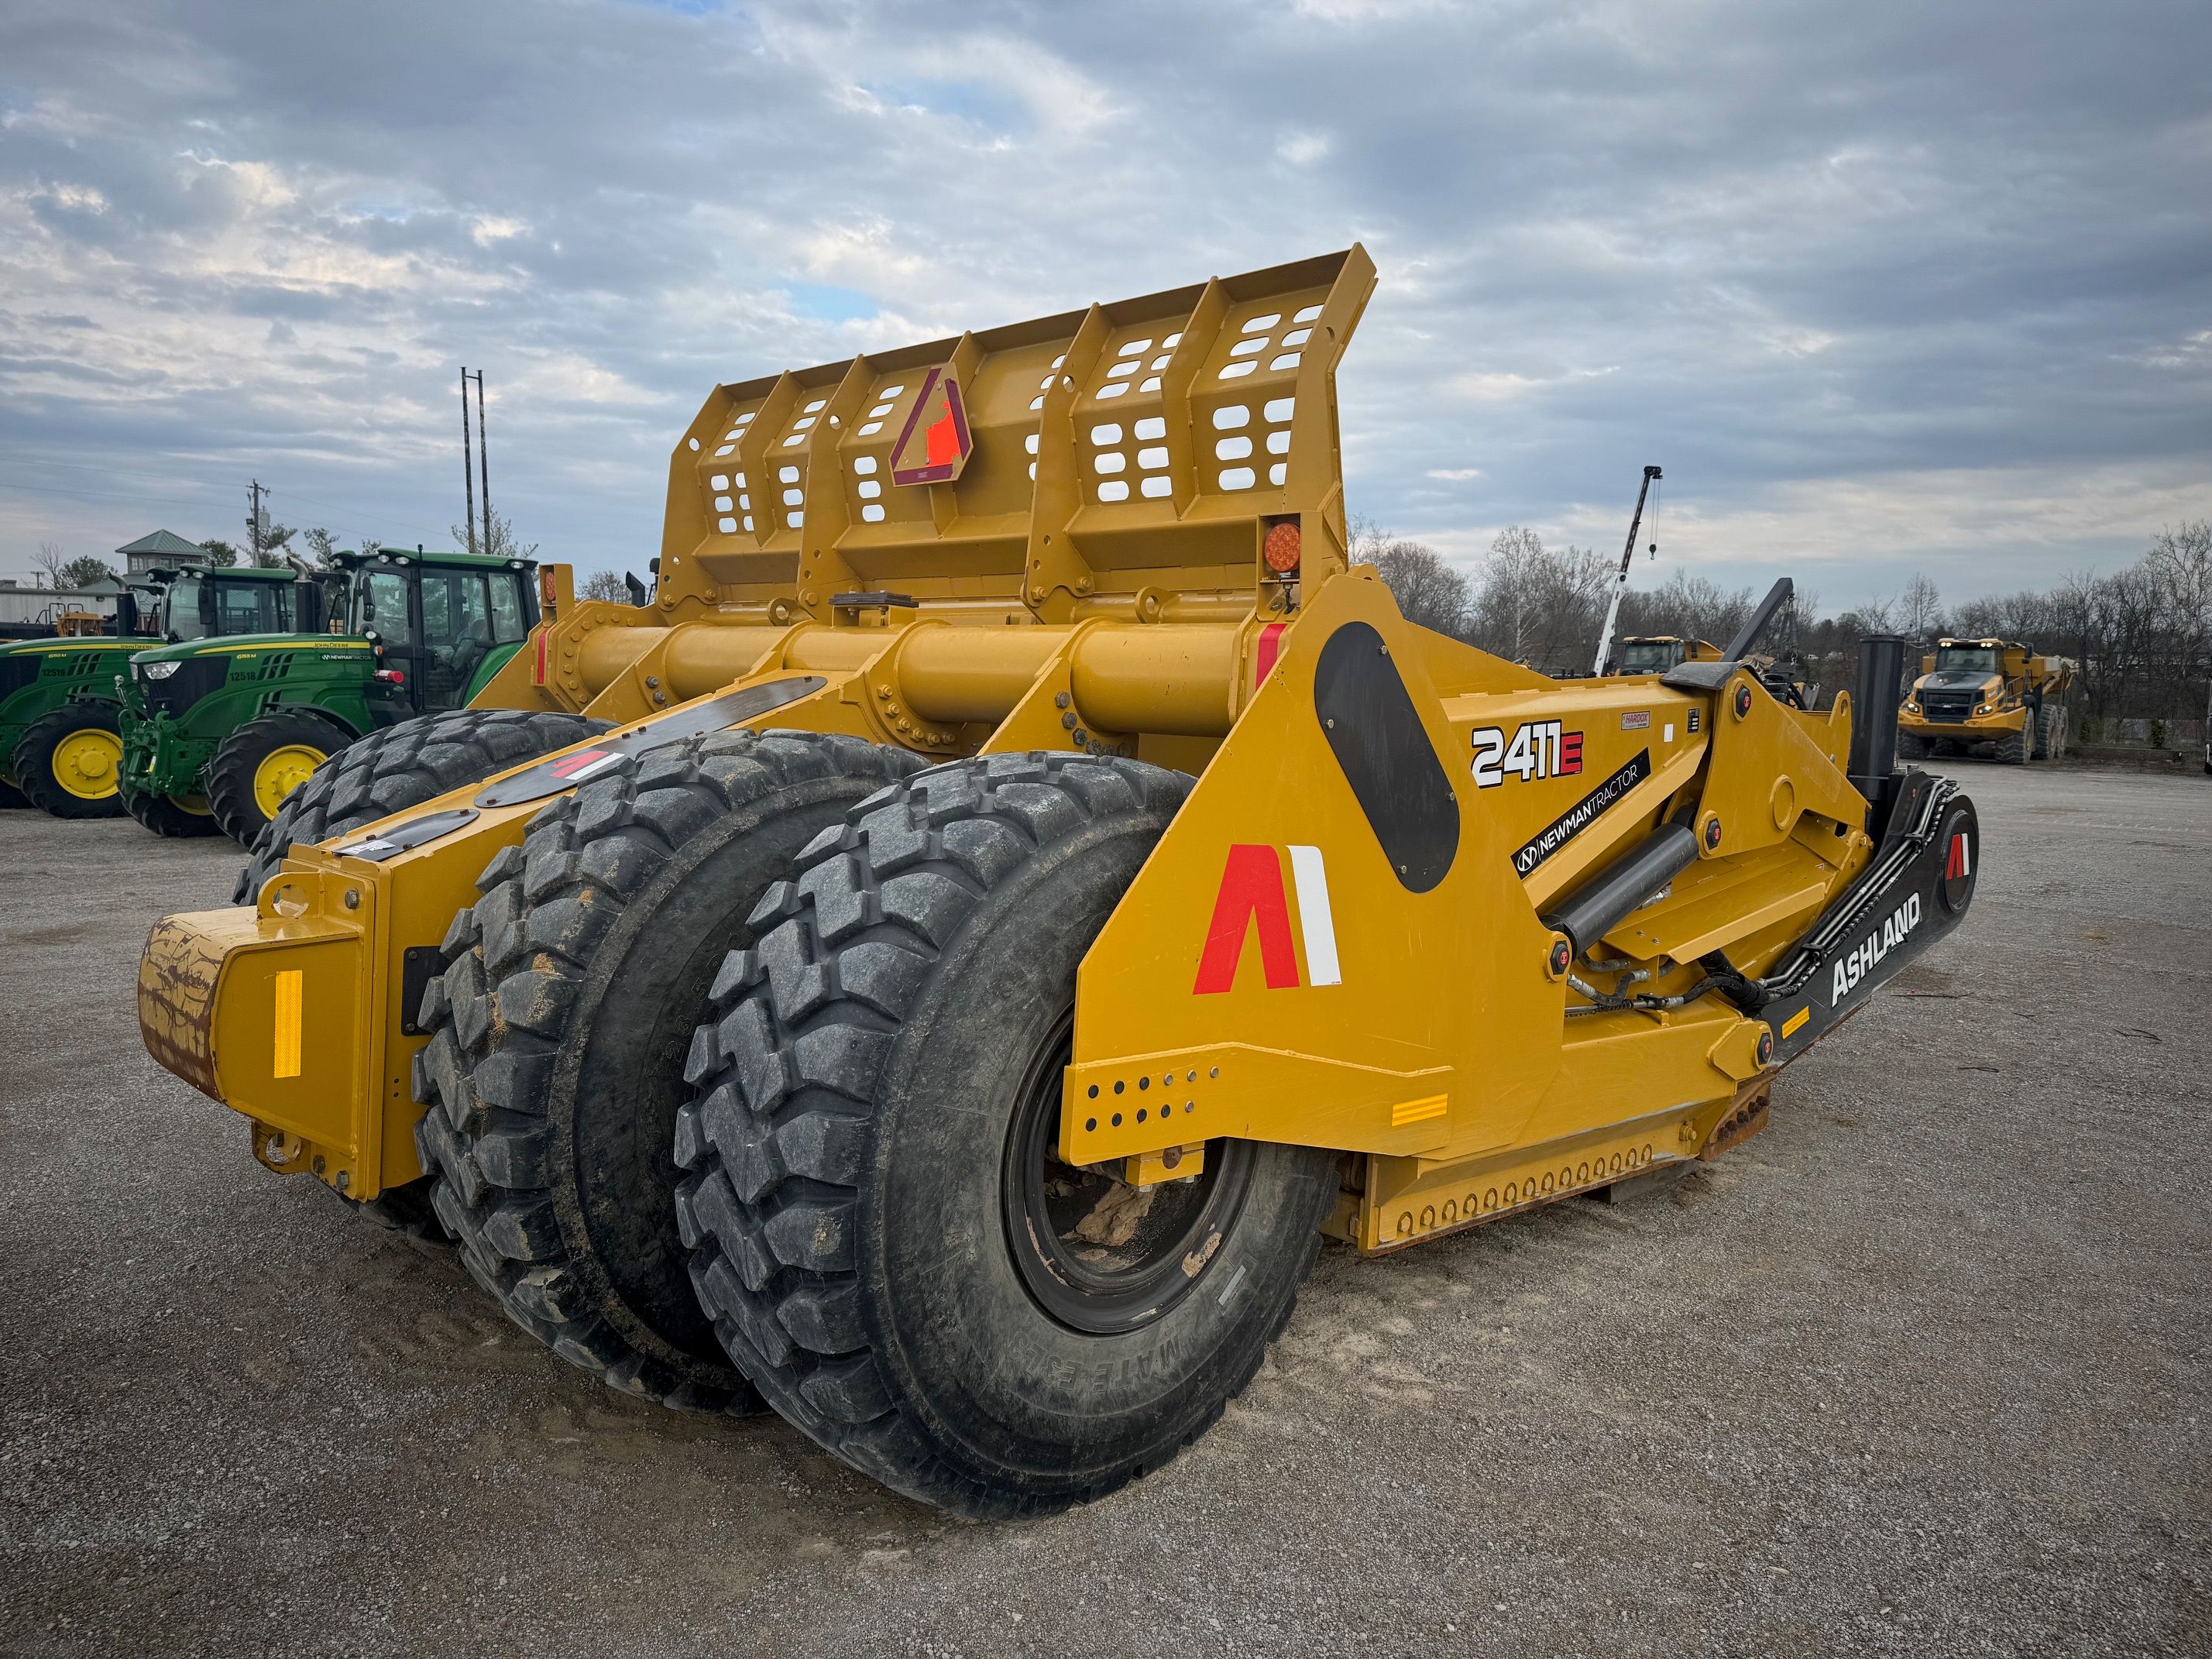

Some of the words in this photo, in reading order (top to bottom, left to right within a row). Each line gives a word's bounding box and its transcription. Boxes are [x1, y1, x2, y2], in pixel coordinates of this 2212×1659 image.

[230, 672, 256, 681] 12518
[1626, 713, 1648, 723] HARDOX
[1471, 719, 1583, 788] 2411E
[1832, 892, 1921, 1008] ASHLAND
